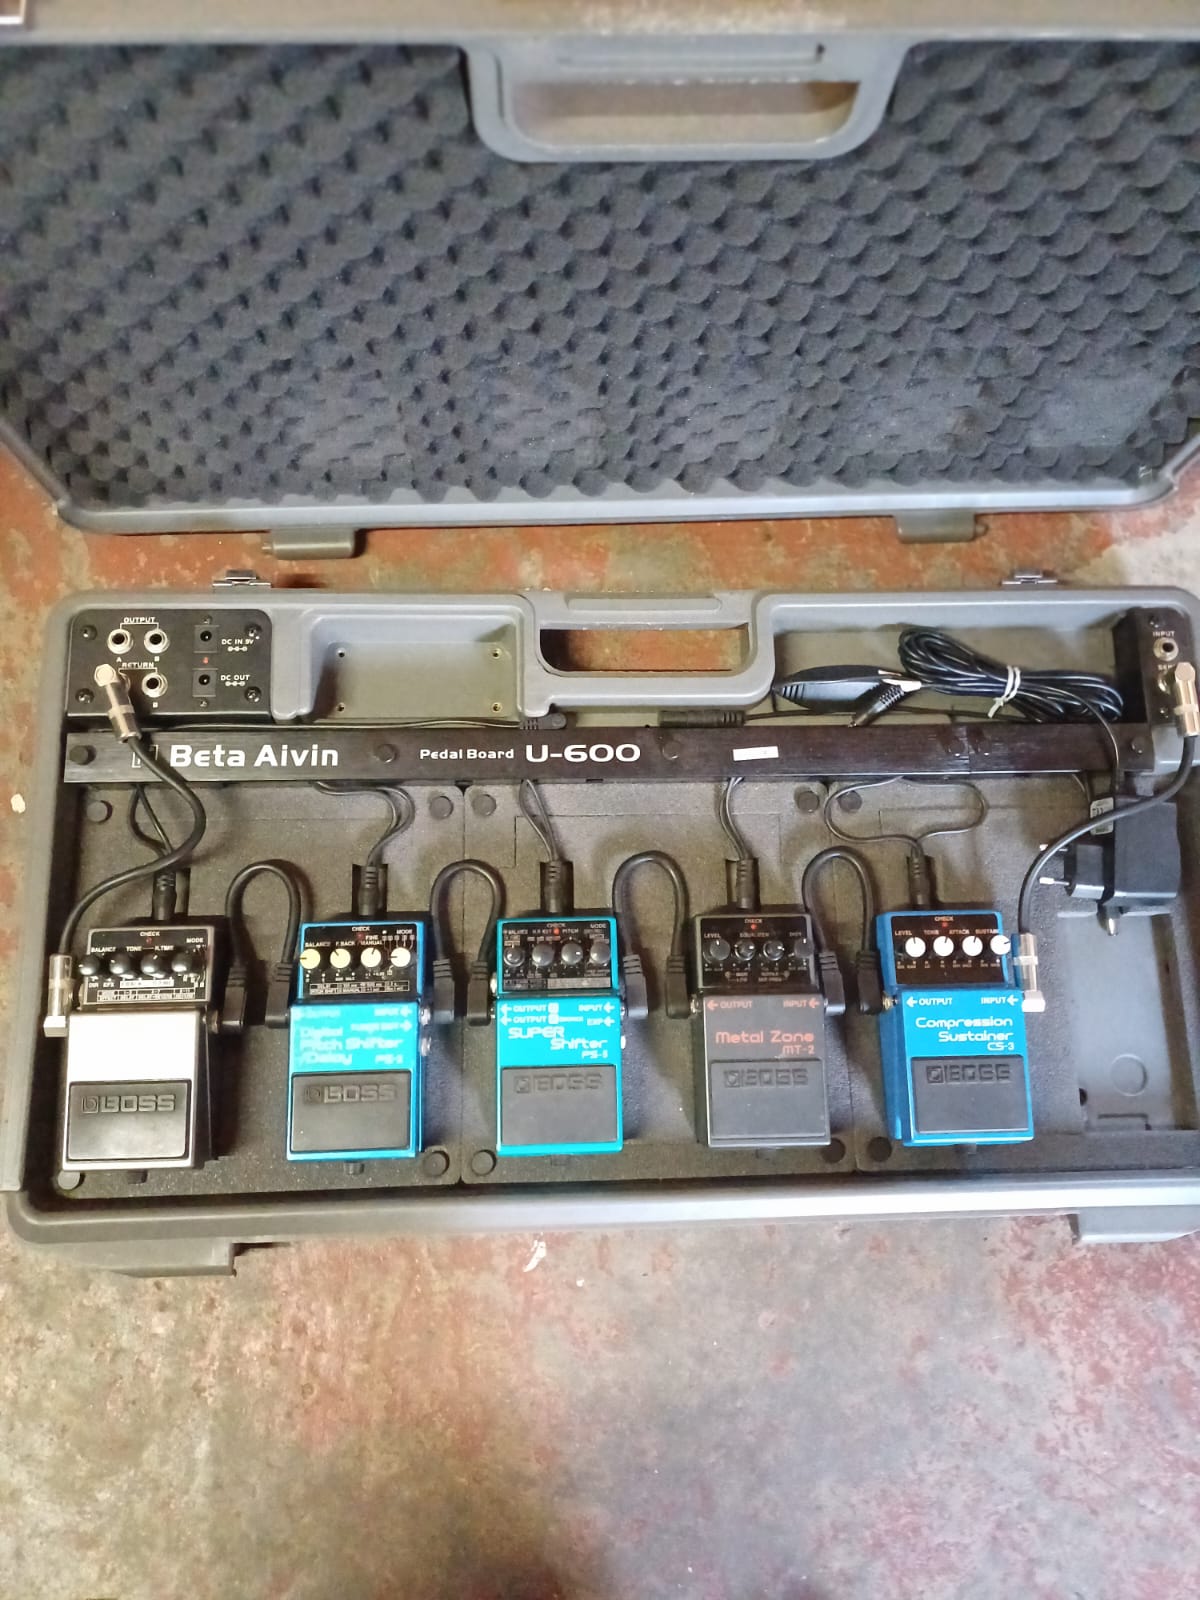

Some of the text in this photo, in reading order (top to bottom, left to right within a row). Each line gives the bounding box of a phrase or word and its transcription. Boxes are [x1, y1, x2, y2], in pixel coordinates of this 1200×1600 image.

[170, 743, 339, 767] Beta Aivin
[419, 743, 641, 762] Pedal Board U-600
[720, 1000, 807, 1009] OUTPUT INPUT
[919, 996, 1007, 1006] OUTPUT INPUT
[513, 1004, 547, 1012] OUTPUT
[513, 1015, 547, 1023] OUTPUT
[915, 1016, 1013, 1030] Compression
[508, 1026, 565, 1039] SUPER
[715, 1030, 815, 1044] Metal Zone
[938, 1030, 1014, 1042] Sustainer
[550, 1037, 608, 1050] Shifter
[781, 1044, 815, 1055] MT-2
[987, 1042, 1015, 1051] CS-3
[743, 1068, 808, 1087] BOSS
[944, 1064, 1010, 1083] BOSS
[533, 1073, 602, 1091] BOSS
[324, 1085, 396, 1103] BOSS
[101, 1095, 175, 1113] BOSS
